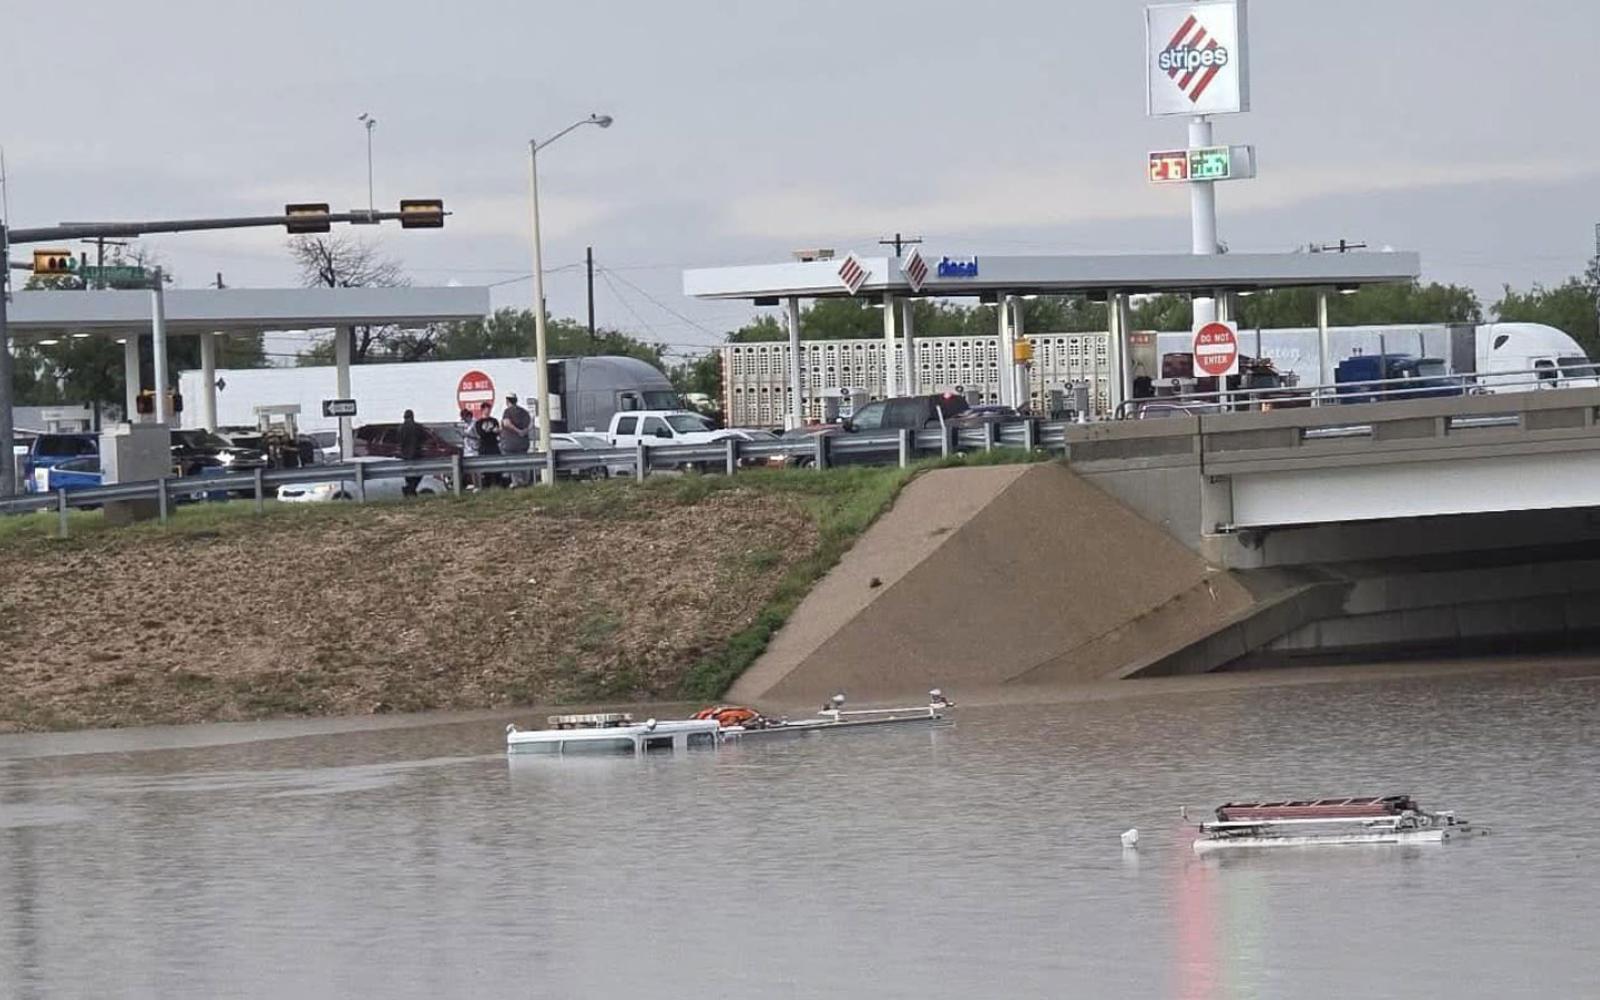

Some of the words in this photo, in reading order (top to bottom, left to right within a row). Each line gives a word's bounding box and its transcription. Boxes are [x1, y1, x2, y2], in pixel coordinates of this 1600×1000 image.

[1160, 45, 1228, 73] stripes
[938, 256, 978, 277] diesel
[1200, 334, 1211, 343] DO
[1214, 332, 1229, 342] NOT
[1203, 355, 1228, 365] ENTER
[463, 381, 473, 390] DO
[475, 380, 489, 389] NOT
